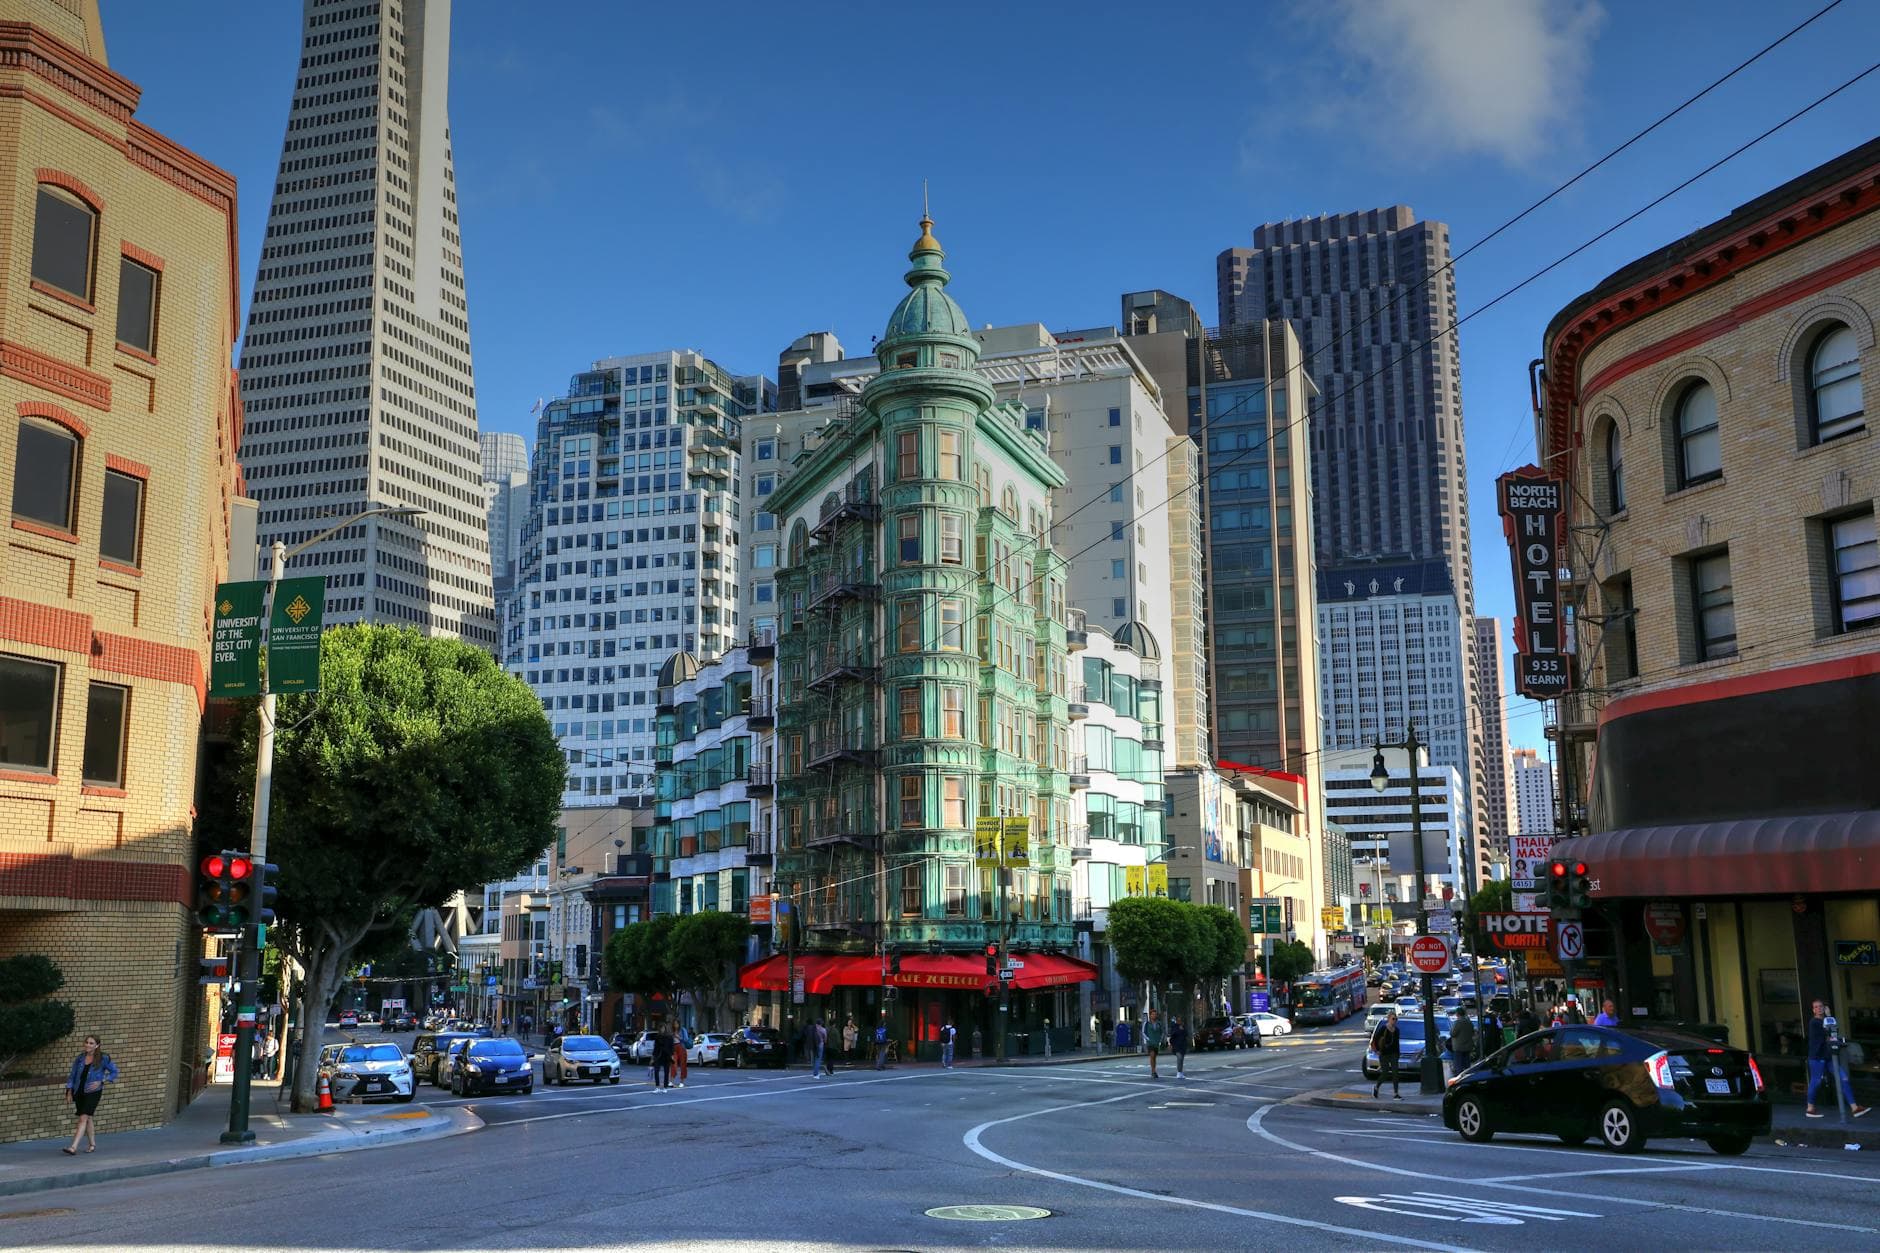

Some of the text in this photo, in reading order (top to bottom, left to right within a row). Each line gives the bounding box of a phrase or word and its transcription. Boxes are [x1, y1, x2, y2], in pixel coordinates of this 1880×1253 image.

[1510, 485, 1557, 497] NORTH
[1510, 497, 1558, 509] BEACH
[1525, 514, 1556, 654] HOTEL
[217, 616, 259, 629] UNIVERSITY
[216, 629, 244, 640] OF THE
[286, 633, 319, 641] FRANCISCO
[215, 639, 253, 651] BEST CITY
[215, 653, 237, 663] EVER.
[1532, 661, 1559, 671] 935
[1525, 674, 1567, 685] KEARNY
[1517, 848, 1549, 858] MASS
[1513, 880, 1532, 888] (415)
[1486, 915, 1550, 933] HOTE
[1503, 934, 1539, 946] NORTH
